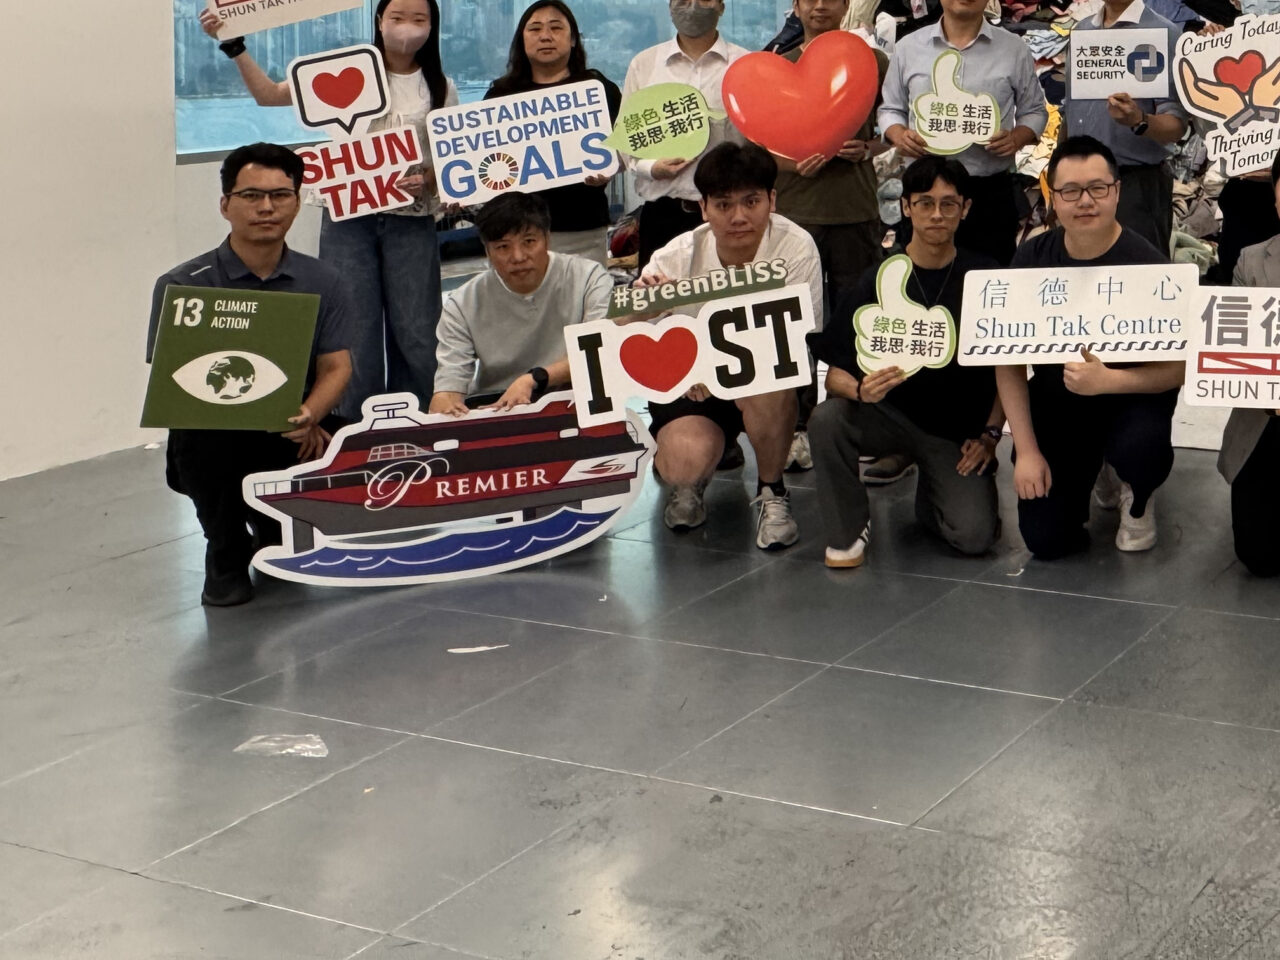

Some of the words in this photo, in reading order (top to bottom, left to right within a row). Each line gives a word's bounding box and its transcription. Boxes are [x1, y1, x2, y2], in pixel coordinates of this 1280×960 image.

[218, 2, 257, 20] SHUN
[1181, 33, 1233, 57] Caring
[1076, 59, 1126, 68] GENERAL
[1076, 71, 1126, 80] SECURITY
[431, 87, 601, 136] SUSTAINABLE
[435, 110, 603, 159] DEVELOPMENT
[1212, 128, 1274, 155] Thriving
[301, 129, 419, 185] SHUN
[1230, 148, 1279, 170] Tomor
[319, 170, 409, 218] TAK
[614, 258, 788, 311] #greenBLISS
[979, 275, 1182, 309] 信德中心
[173, 297, 204, 327] 13
[214, 300, 258, 314] CLIMATE
[210, 316, 250, 329] ACTION
[975, 317, 1036, 339] Shun
[1046, 315, 1091, 336] Tak
[1100, 314, 1182, 336] Centre
[577, 332, 614, 416] I
[708, 296, 803, 389] ST
[1196, 380, 1259, 400] SHUN
[364, 458, 550, 511] PREMIER
